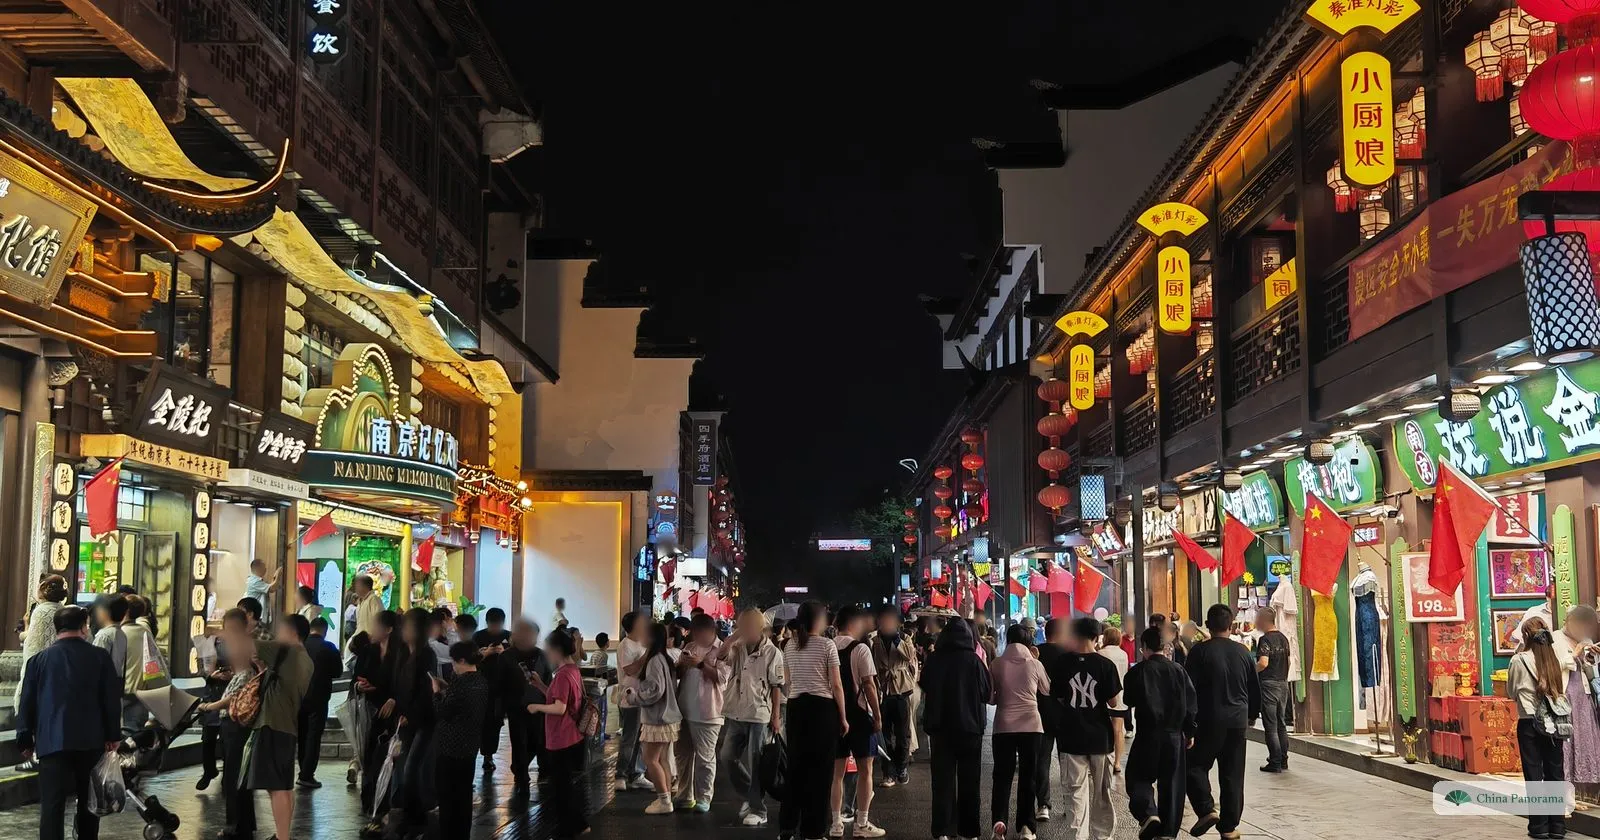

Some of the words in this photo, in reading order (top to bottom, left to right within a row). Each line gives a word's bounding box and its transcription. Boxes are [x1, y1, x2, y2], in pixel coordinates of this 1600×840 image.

[1350, 68, 1385, 167] 小厨娘
[1150, 209, 1199, 226] 秦淮灯彩
[1164, 256, 1185, 322] 小厨娘
[1074, 352, 1089, 401] 小厨娘
[333, 460, 395, 481] NANJING
[697, 424, 711, 473] 四季府酒店
[1417, 600, 1443, 613] 198
